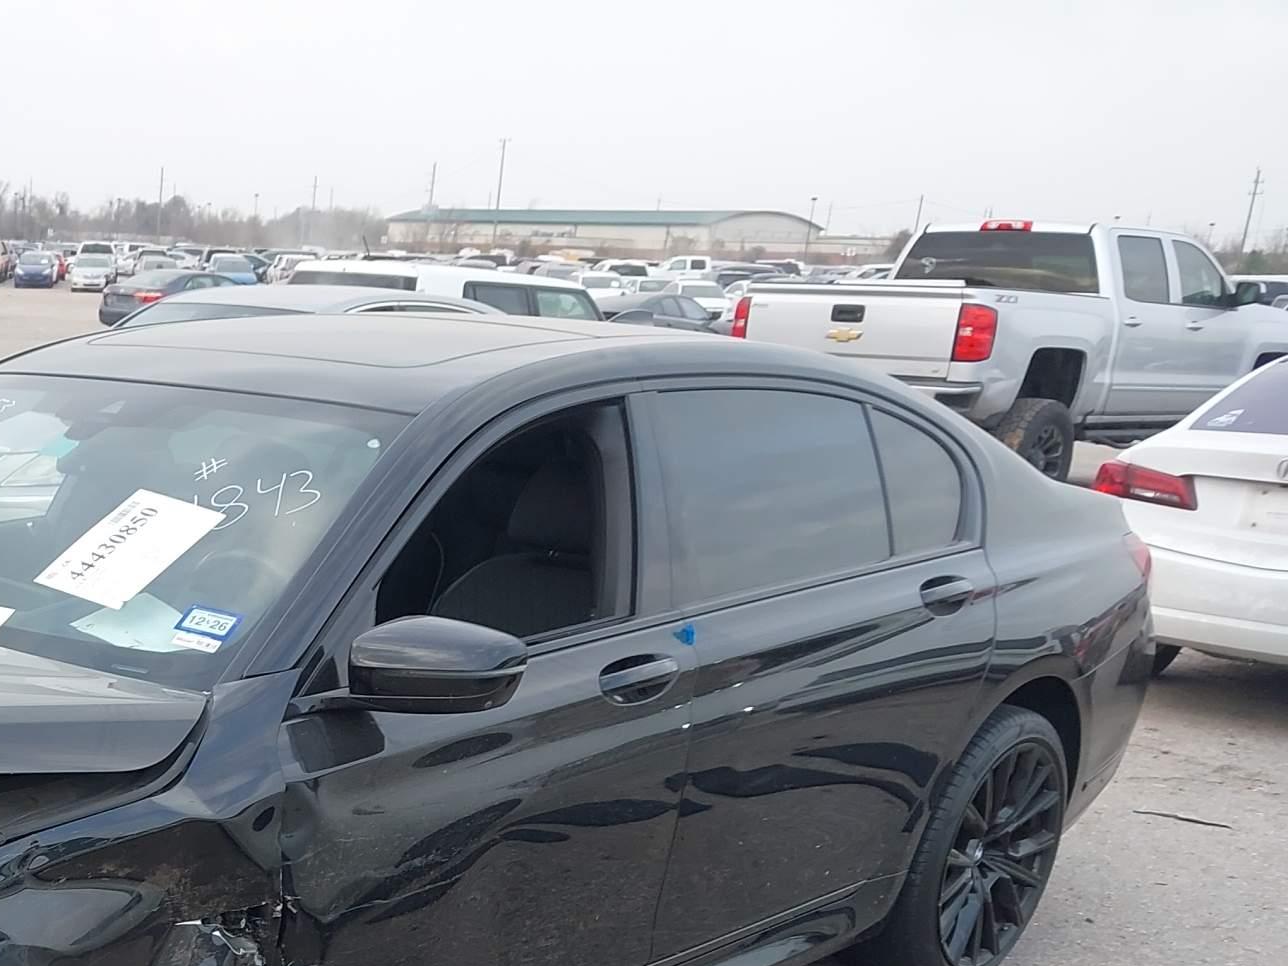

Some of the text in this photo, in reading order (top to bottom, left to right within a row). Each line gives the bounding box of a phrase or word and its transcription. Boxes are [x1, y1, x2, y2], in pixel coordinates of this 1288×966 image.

[194, 458, 228, 481] #
[194, 470, 321, 530] 843
[70, 507, 159, 581] 44430850
[188, 615, 229, 631] 12 26
